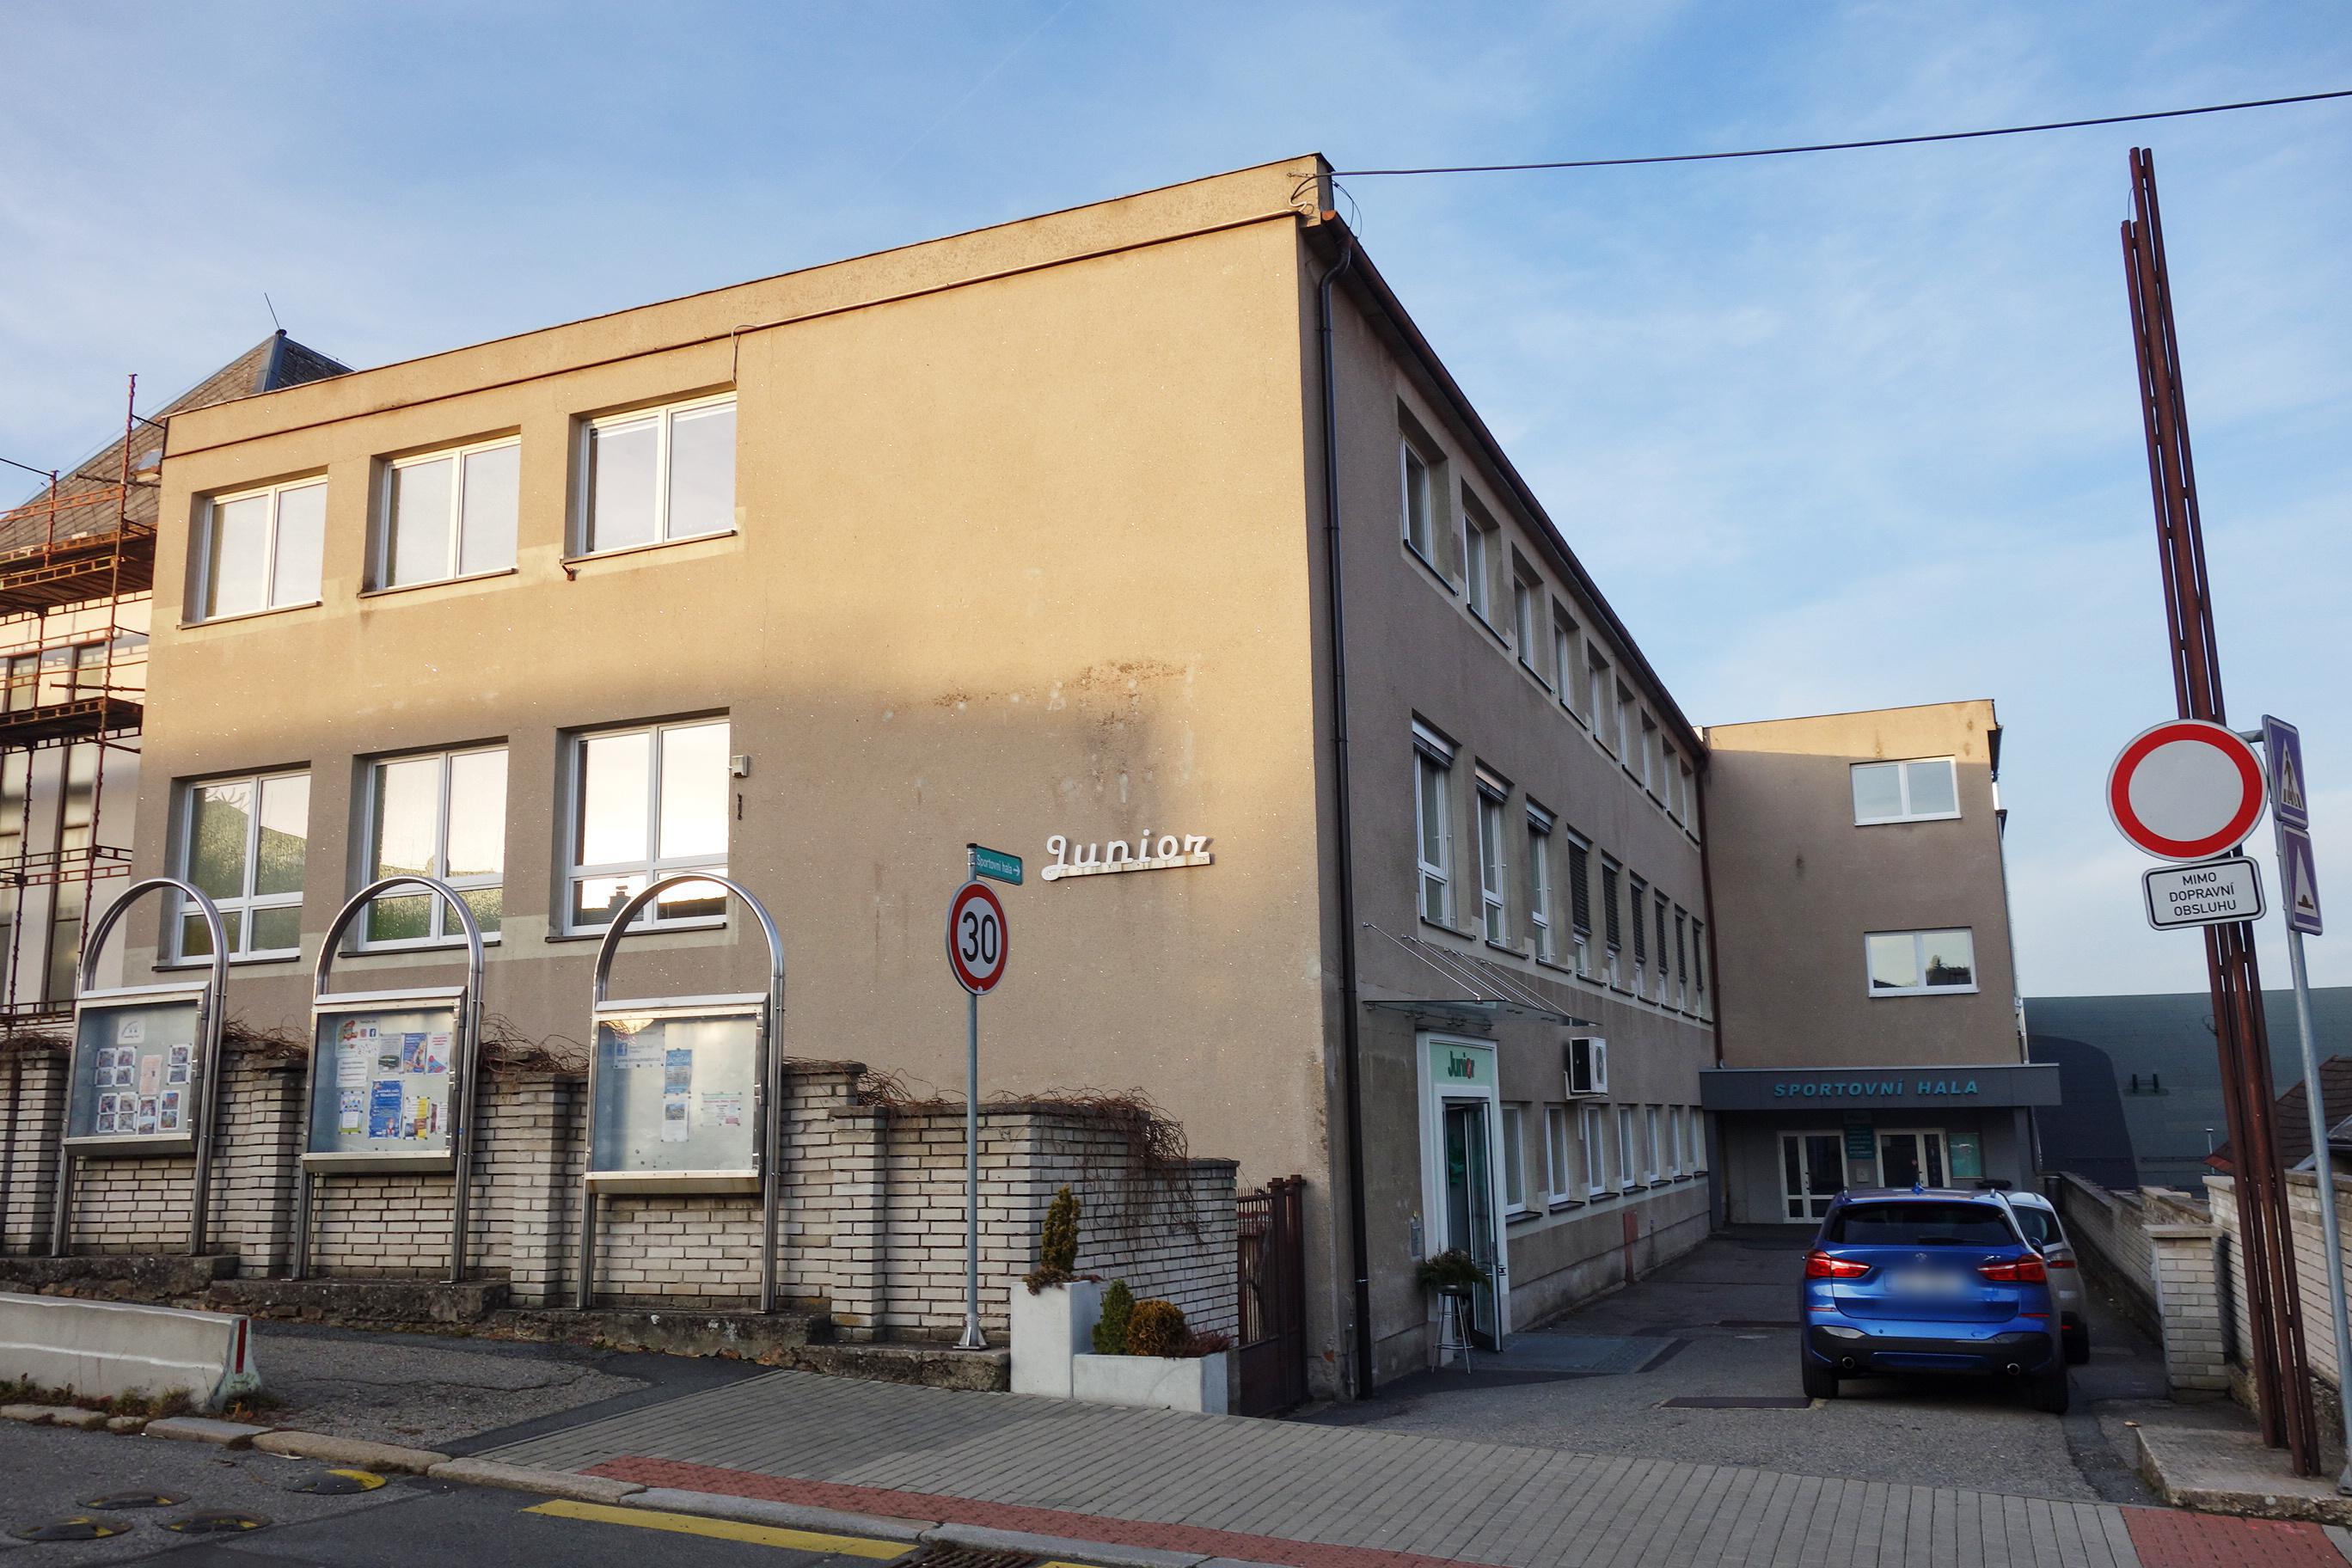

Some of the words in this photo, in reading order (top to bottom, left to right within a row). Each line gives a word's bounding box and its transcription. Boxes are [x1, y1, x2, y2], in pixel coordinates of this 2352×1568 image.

[1001, 859, 1013, 875] hala
[2182, 872, 2217, 886] MIMO
[2169, 881, 2235, 903] DOPRAVNÍ
[2173, 899, 2237, 916] OBSLUHU
[962, 910, 997, 965] 30
[1448, 1050, 1475, 1080] Junior
[1773, 1078, 1904, 1097] SPORTOVNÍ
[1917, 1081, 1978, 1096] HALA
